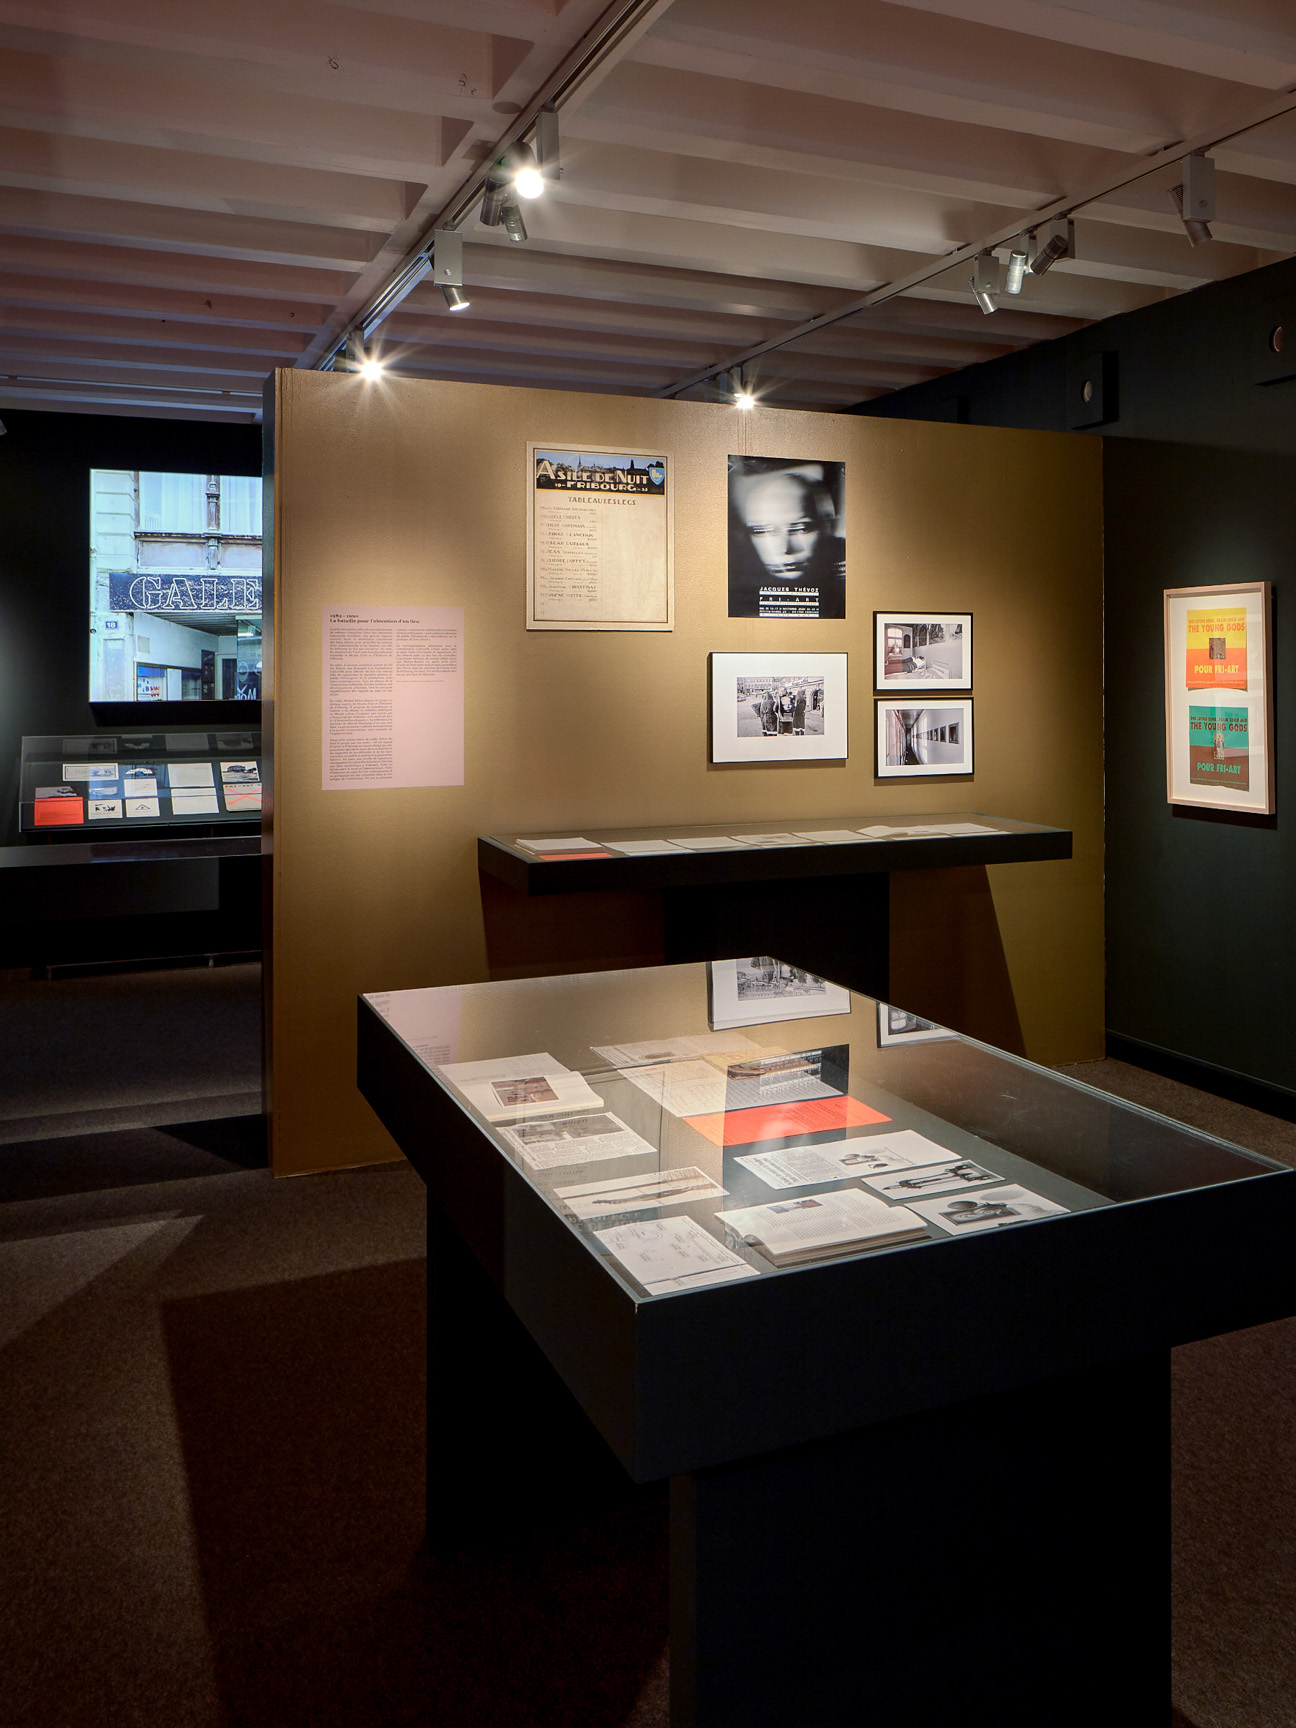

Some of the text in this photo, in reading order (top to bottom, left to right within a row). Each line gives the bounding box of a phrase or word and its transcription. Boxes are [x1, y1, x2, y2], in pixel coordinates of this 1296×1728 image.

[536, 460, 649, 485] ASILE DE NUIT
[567, 481, 636, 492] FRIBOURG
[129, 576, 259, 609] GALE
[1188, 622, 1245, 633] THE YOUNG GODS
[1194, 664, 1239, 674] POUR FRI-ART
[1190, 722, 1248, 732] THE YOUNG GODS
[1197, 762, 1241, 774] POUR FRI-ART
